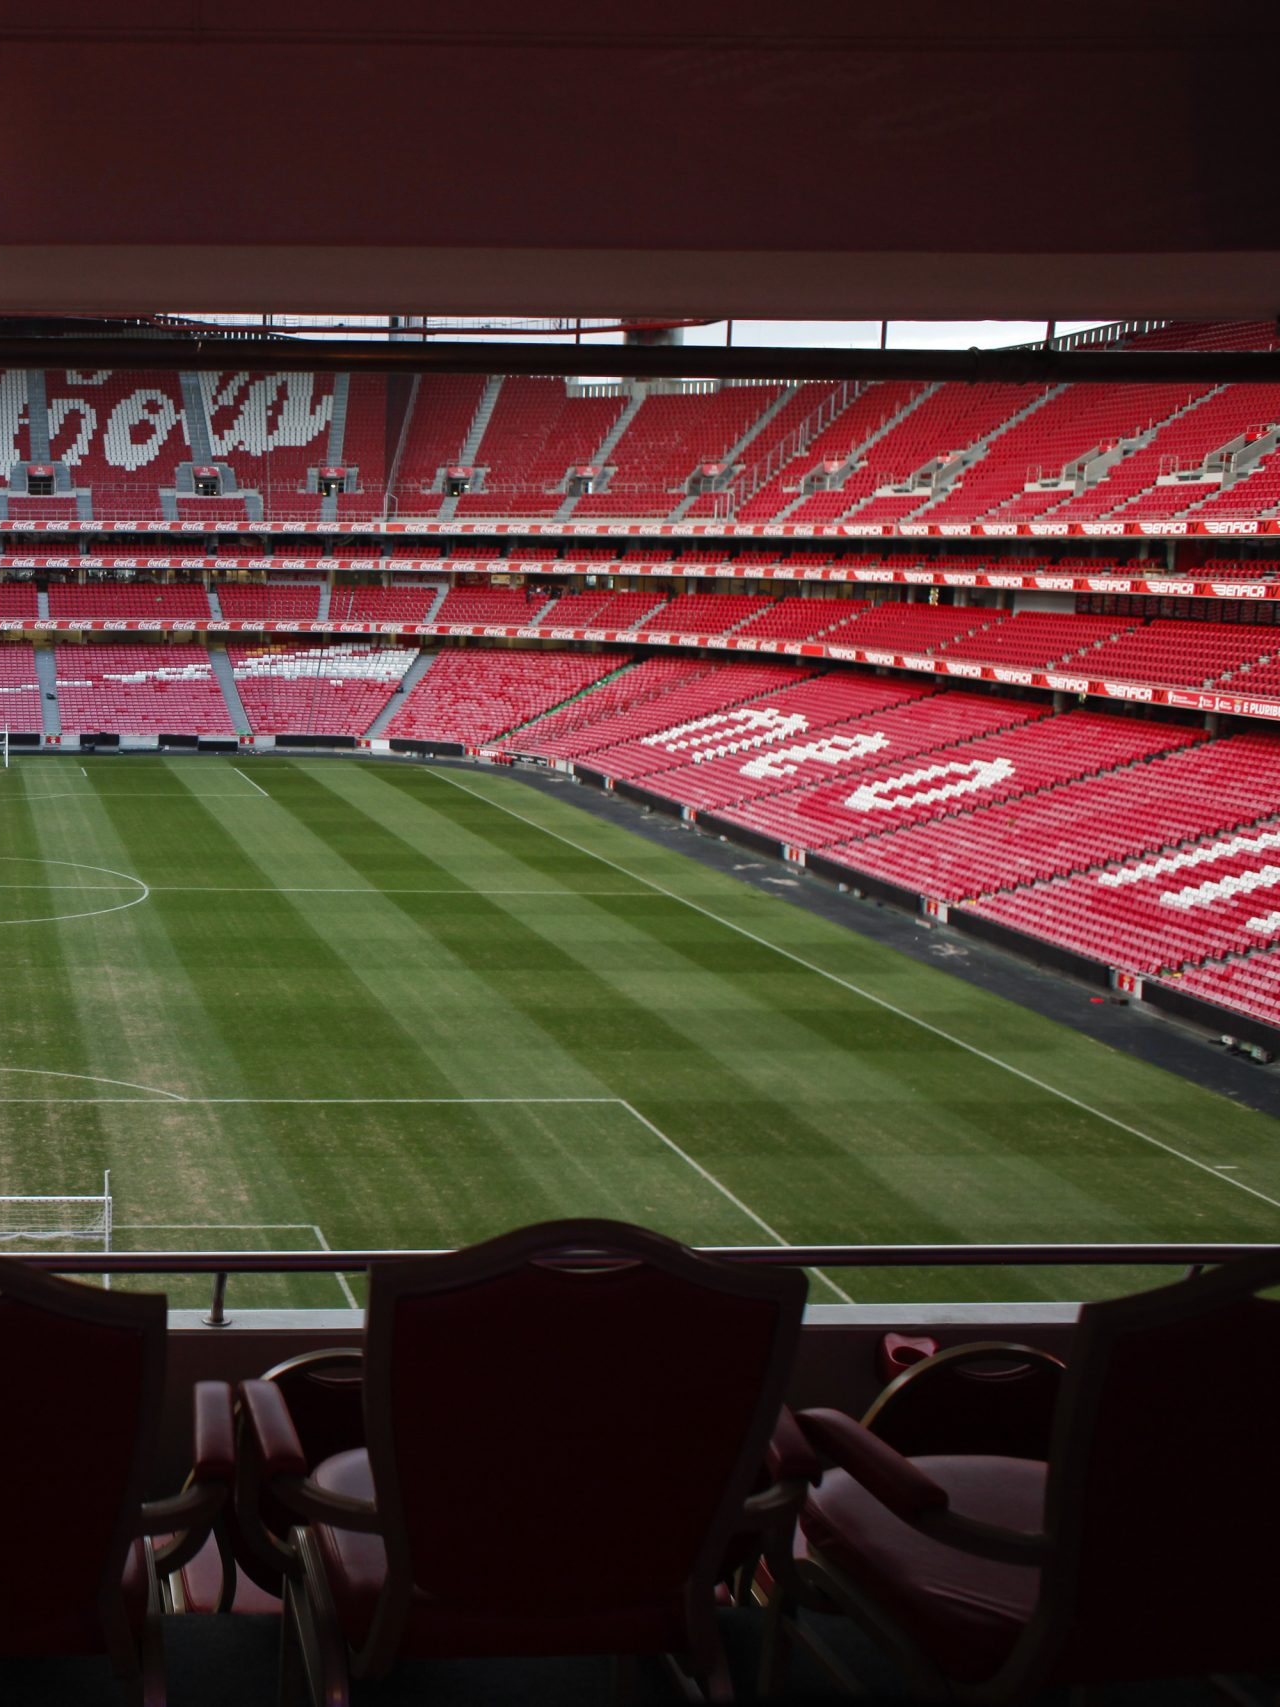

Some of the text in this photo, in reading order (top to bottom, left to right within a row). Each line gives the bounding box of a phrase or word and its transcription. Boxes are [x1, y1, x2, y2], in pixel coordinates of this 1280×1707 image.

[882, 524, 892, 534] TV
[1028, 522, 1068, 534] BENFICA
[1068, 522, 1078, 533] TV
[1080, 522, 1124, 533] BENFICA
[1124, 521, 1135, 533] TV
[1139, 521, 1187, 533] BENFICA
[1187, 521, 1198, 532] TV
[1203, 520, 1257, 533] BENFICA
[1258, 520, 1271, 532] TV
[893, 573, 903, 584] TV
[1073, 577, 1083, 590] TV
[1087, 578, 1130, 592] BENFICA
[1130, 579, 1141, 592] TV
[1145, 579, 1194, 594] BENFICA
[1194, 581, 1206, 594] TV
[1211, 581, 1265, 597] BENFICA
[1265, 582, 1279, 597] TV
[1031, 674, 1040, 685] TV
[1046, 675, 1088, 691] BENFICA
[1088, 681, 1098, 692] TV
[1104, 682, 1152, 701] BENFICA
[1152, 690, 1163, 702] TV
[1249, 702, 1280, 717] PLURIB
